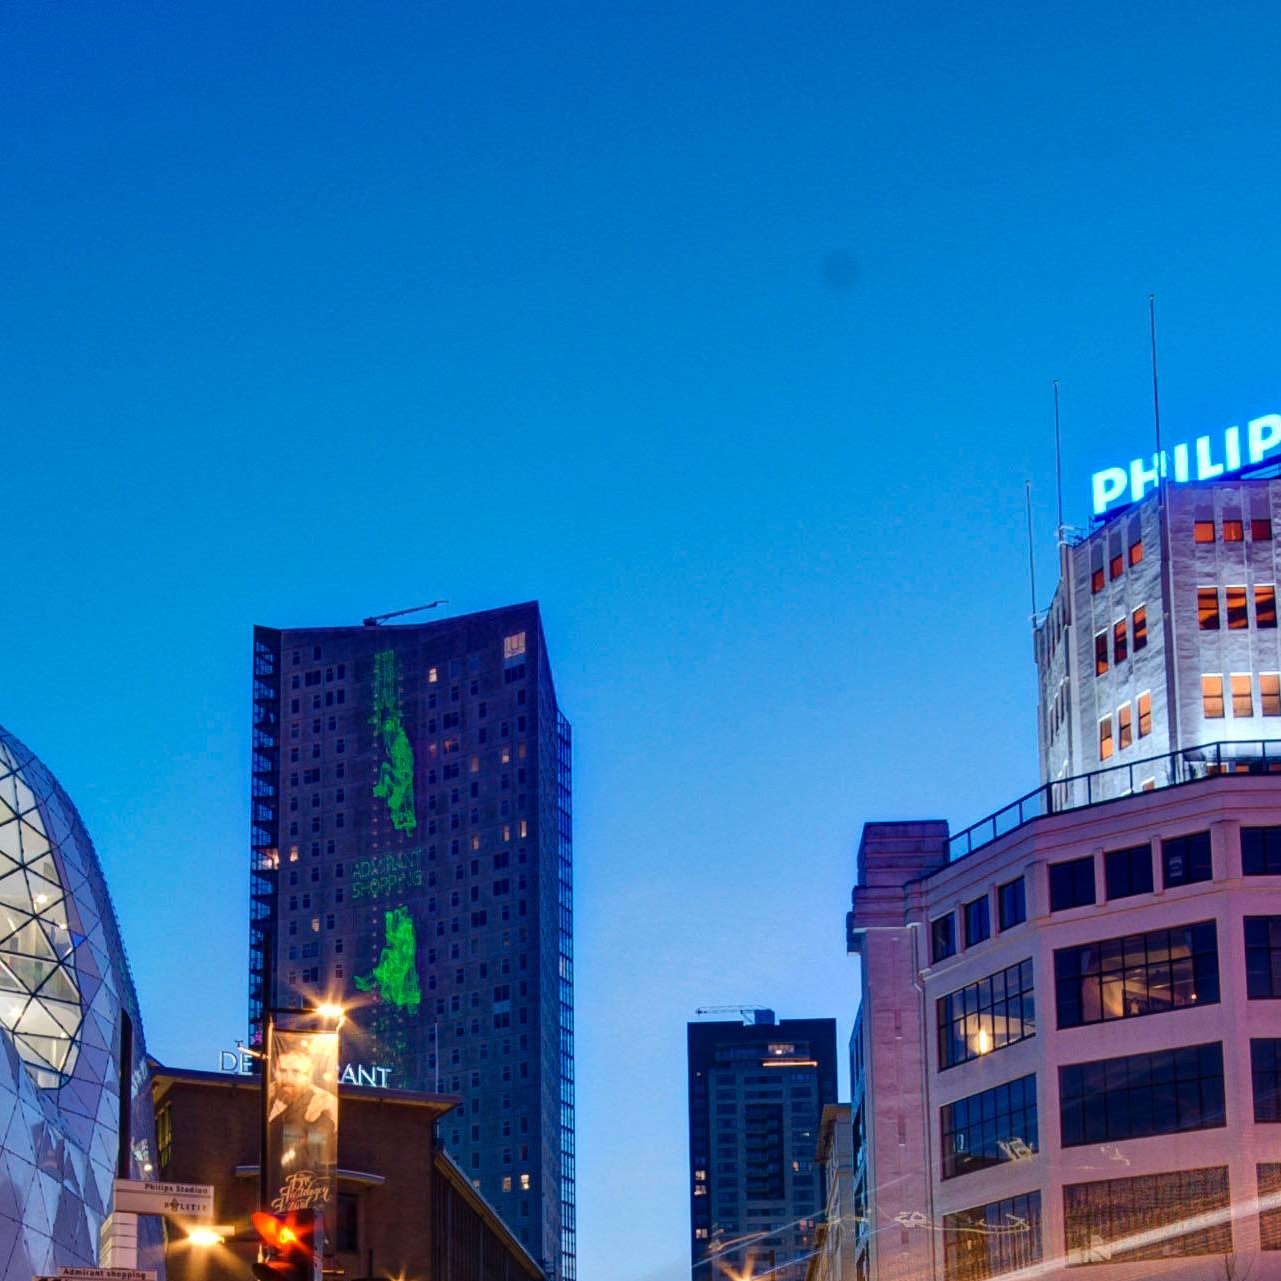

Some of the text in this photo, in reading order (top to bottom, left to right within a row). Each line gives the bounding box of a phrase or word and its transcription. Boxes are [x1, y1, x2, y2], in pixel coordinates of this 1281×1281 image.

[145, 1183, 208, 1194] Philips Stadion
[164, 1199, 207, 1212] PLITIE
[63, 1268, 146, 1280] Admirant shopping
